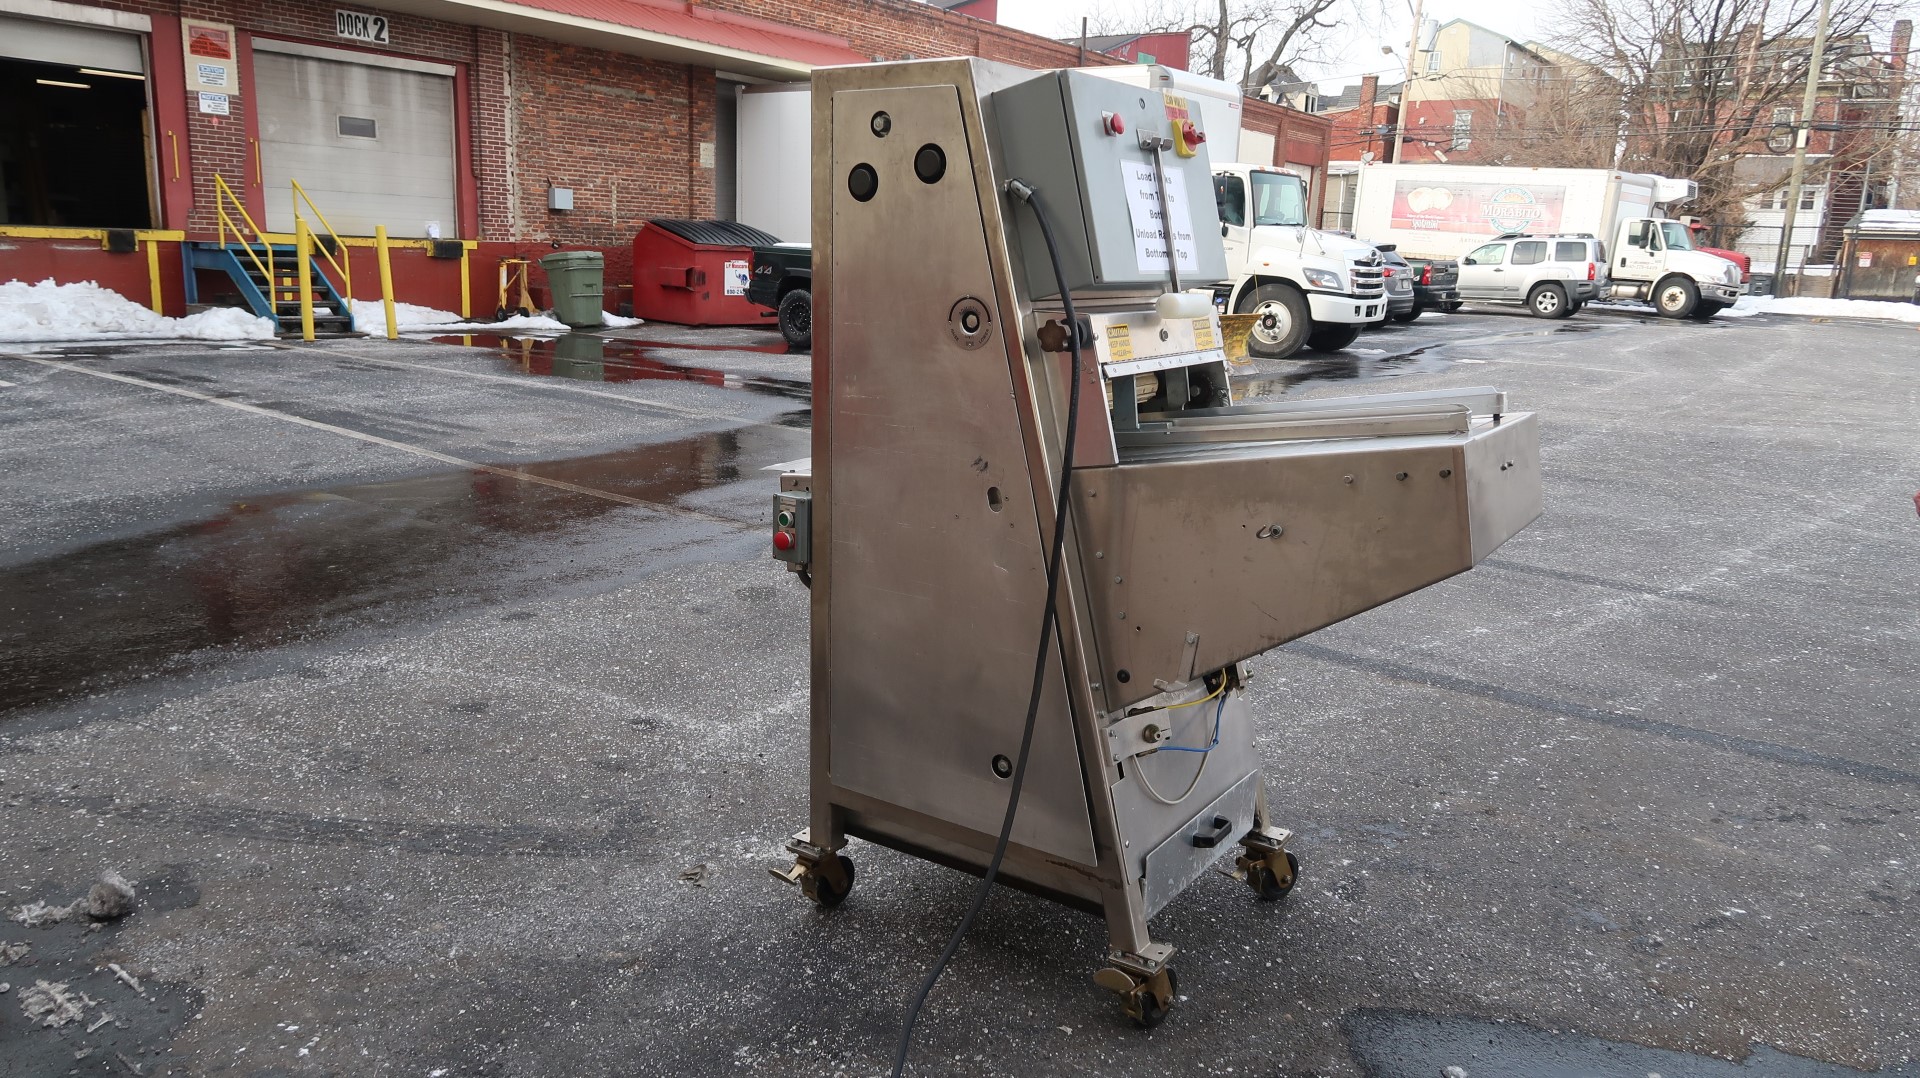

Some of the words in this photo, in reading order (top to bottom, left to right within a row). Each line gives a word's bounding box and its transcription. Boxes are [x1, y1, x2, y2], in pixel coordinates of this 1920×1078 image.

[338, 12, 370, 38] DOCK
[373, 17, 386, 42] 2
[201, 94, 226, 102] NOTICE
[1136, 170, 1152, 181] Load
[1140, 189, 1154, 201] from
[1482, 204, 1541, 219] MORABITO
[1136, 228, 1157, 239] Unload
[1177, 231, 1191, 241] from
[1145, 248, 1168, 258] Bottom
[1176, 249, 1187, 261] Top
[1107, 327, 1129, 337] CAUTION
